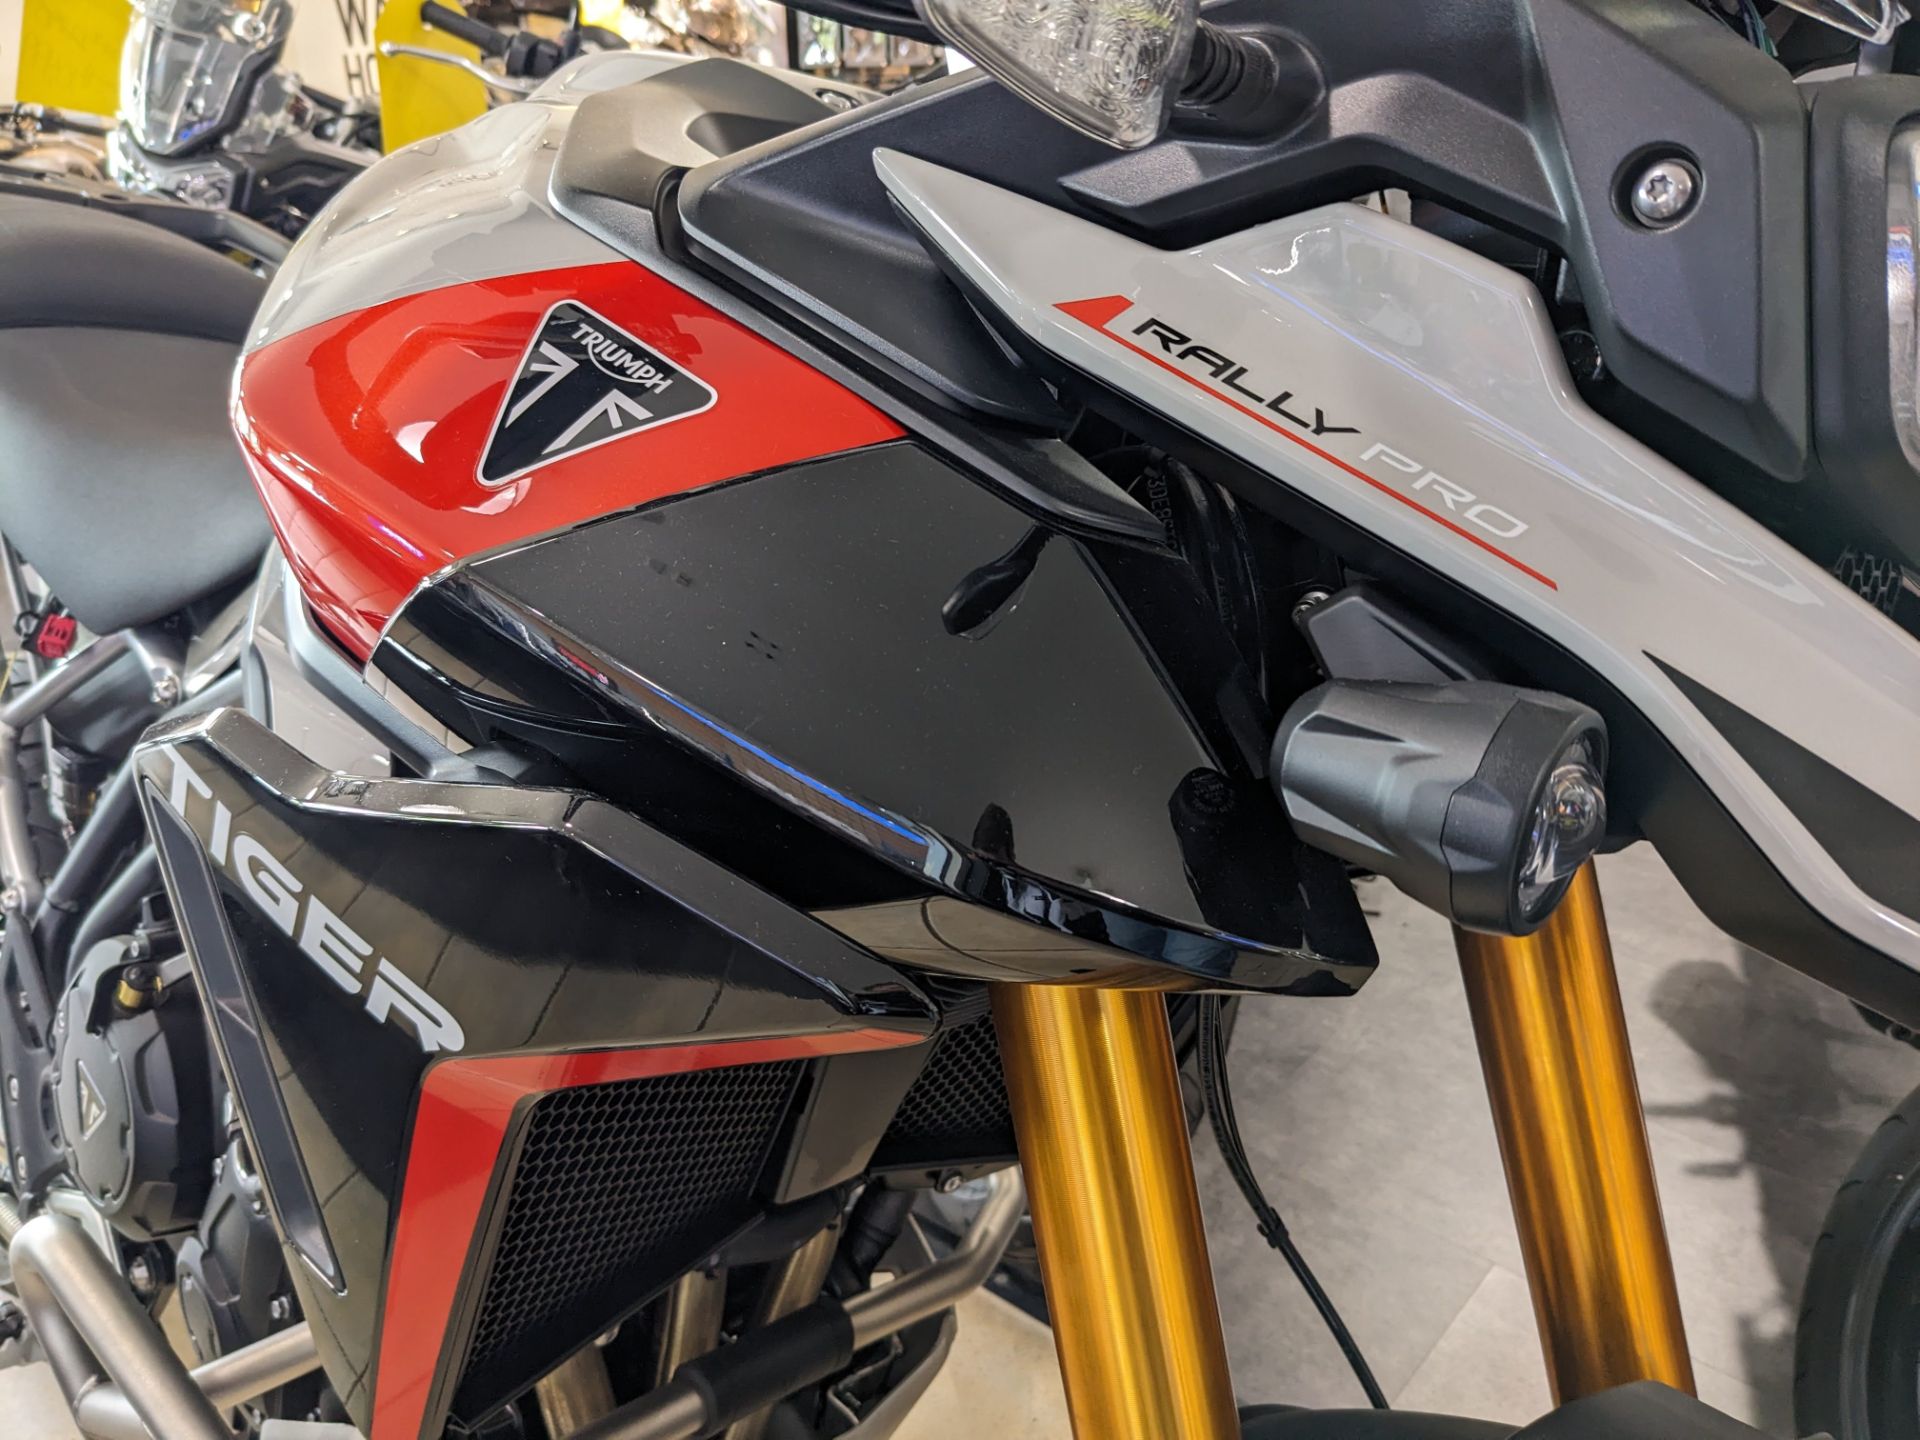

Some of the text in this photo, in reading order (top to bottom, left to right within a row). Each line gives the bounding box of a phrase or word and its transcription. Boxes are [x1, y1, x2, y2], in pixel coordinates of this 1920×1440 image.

[571, 322, 674, 395] TRIUMPH
[1132, 317, 1529, 539] RALLY PRO
[161, 743, 465, 1053] TIGER
